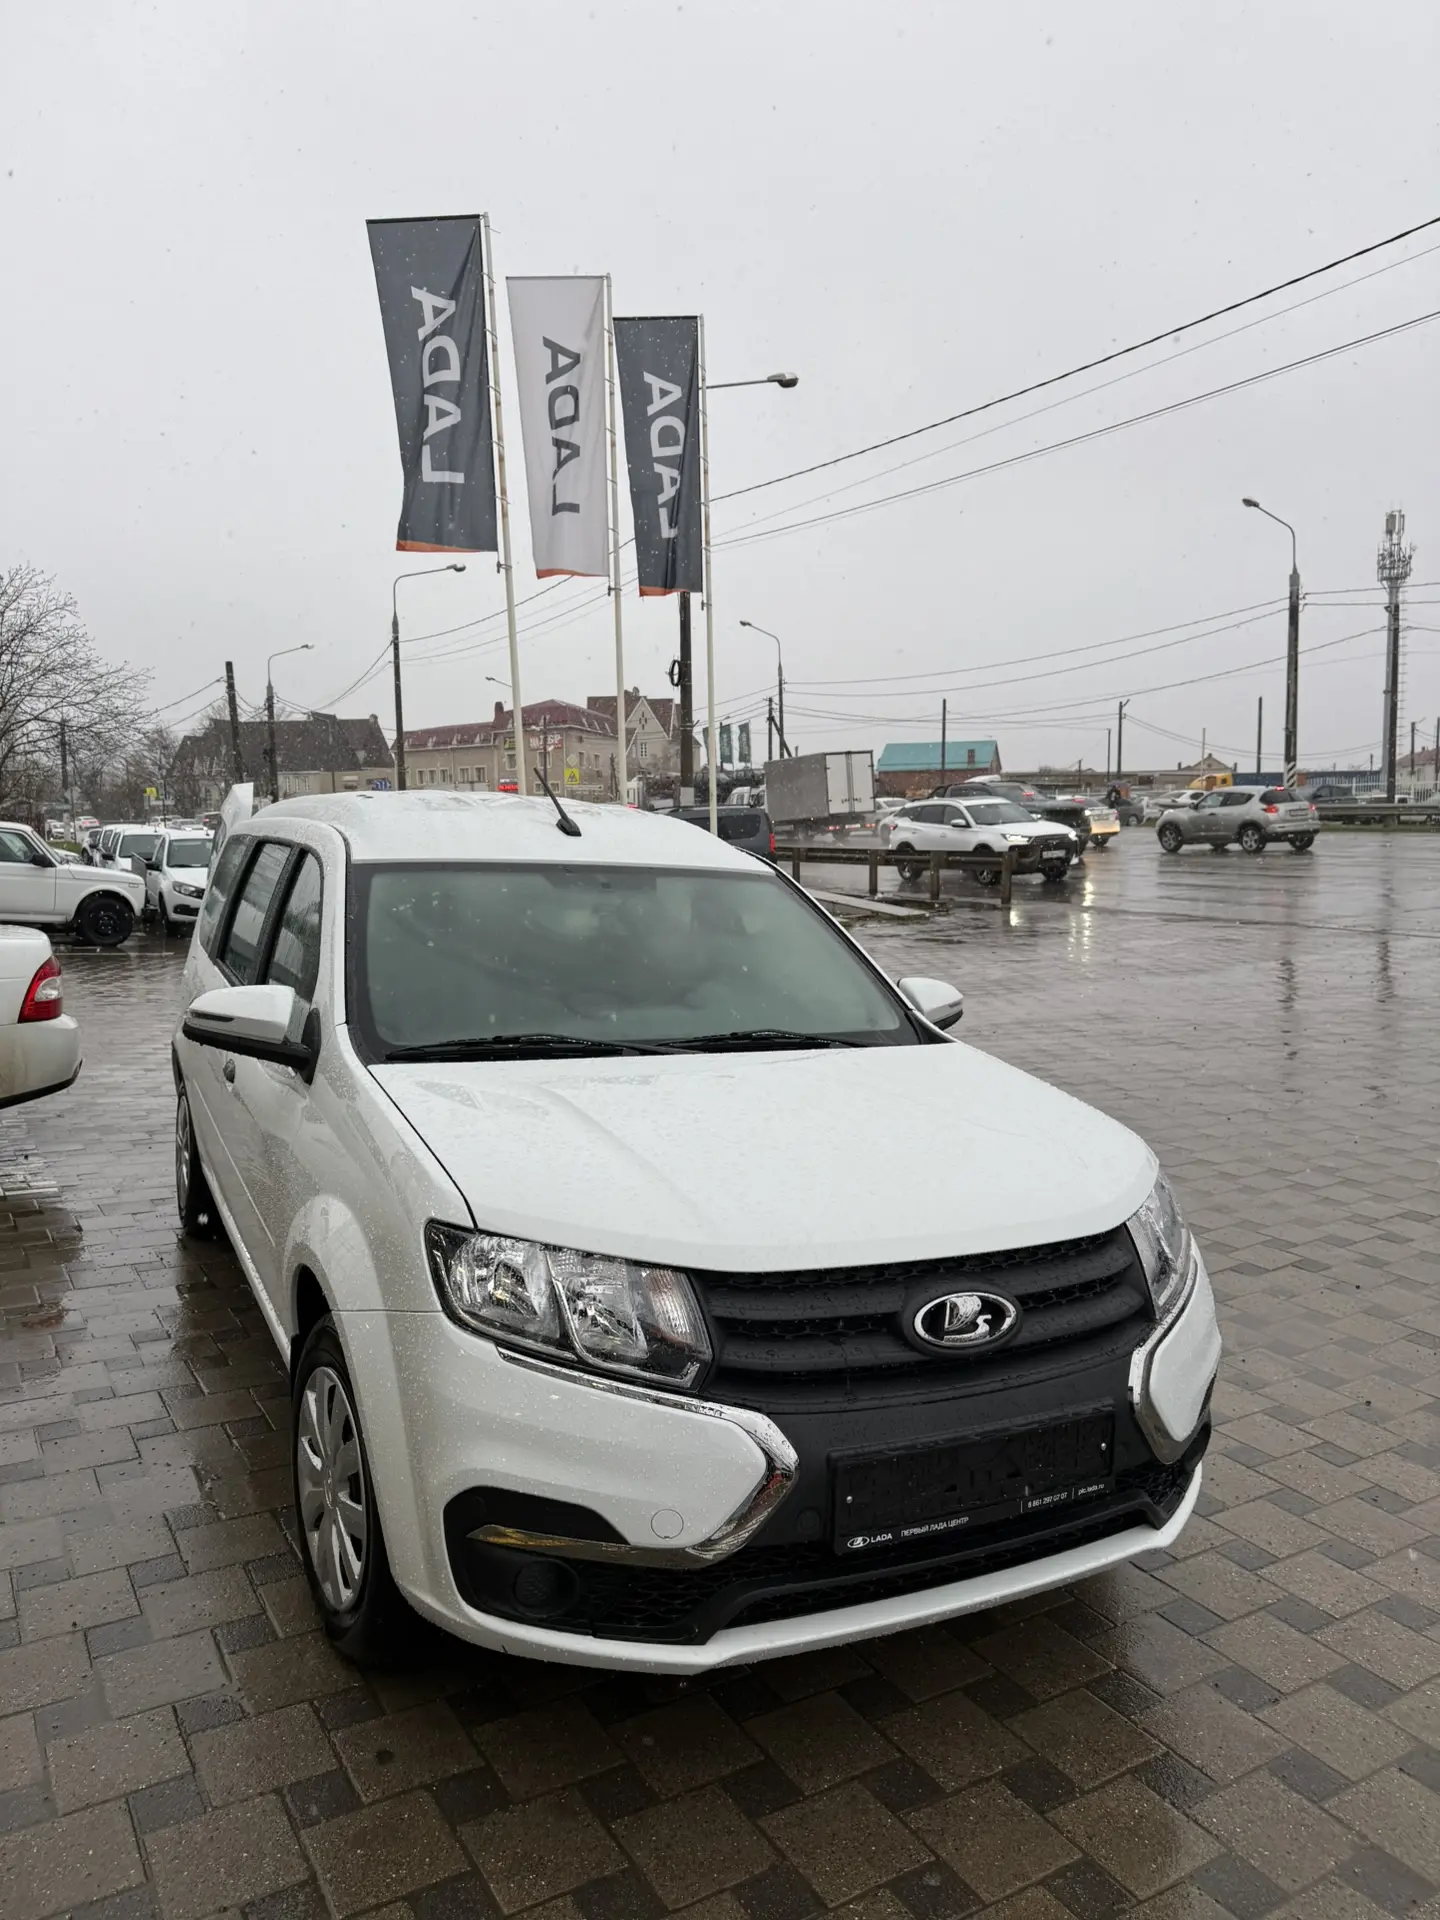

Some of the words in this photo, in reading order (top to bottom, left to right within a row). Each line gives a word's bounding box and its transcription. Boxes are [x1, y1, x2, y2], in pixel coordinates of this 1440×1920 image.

[870, 1532, 893, 1543] LADA
[900, 1524, 929, 1538] ПЕРВЫЙ
[929, 1522, 948, 1532] ЛАДА
[947, 1516, 970, 1528] ЦЕНТР
